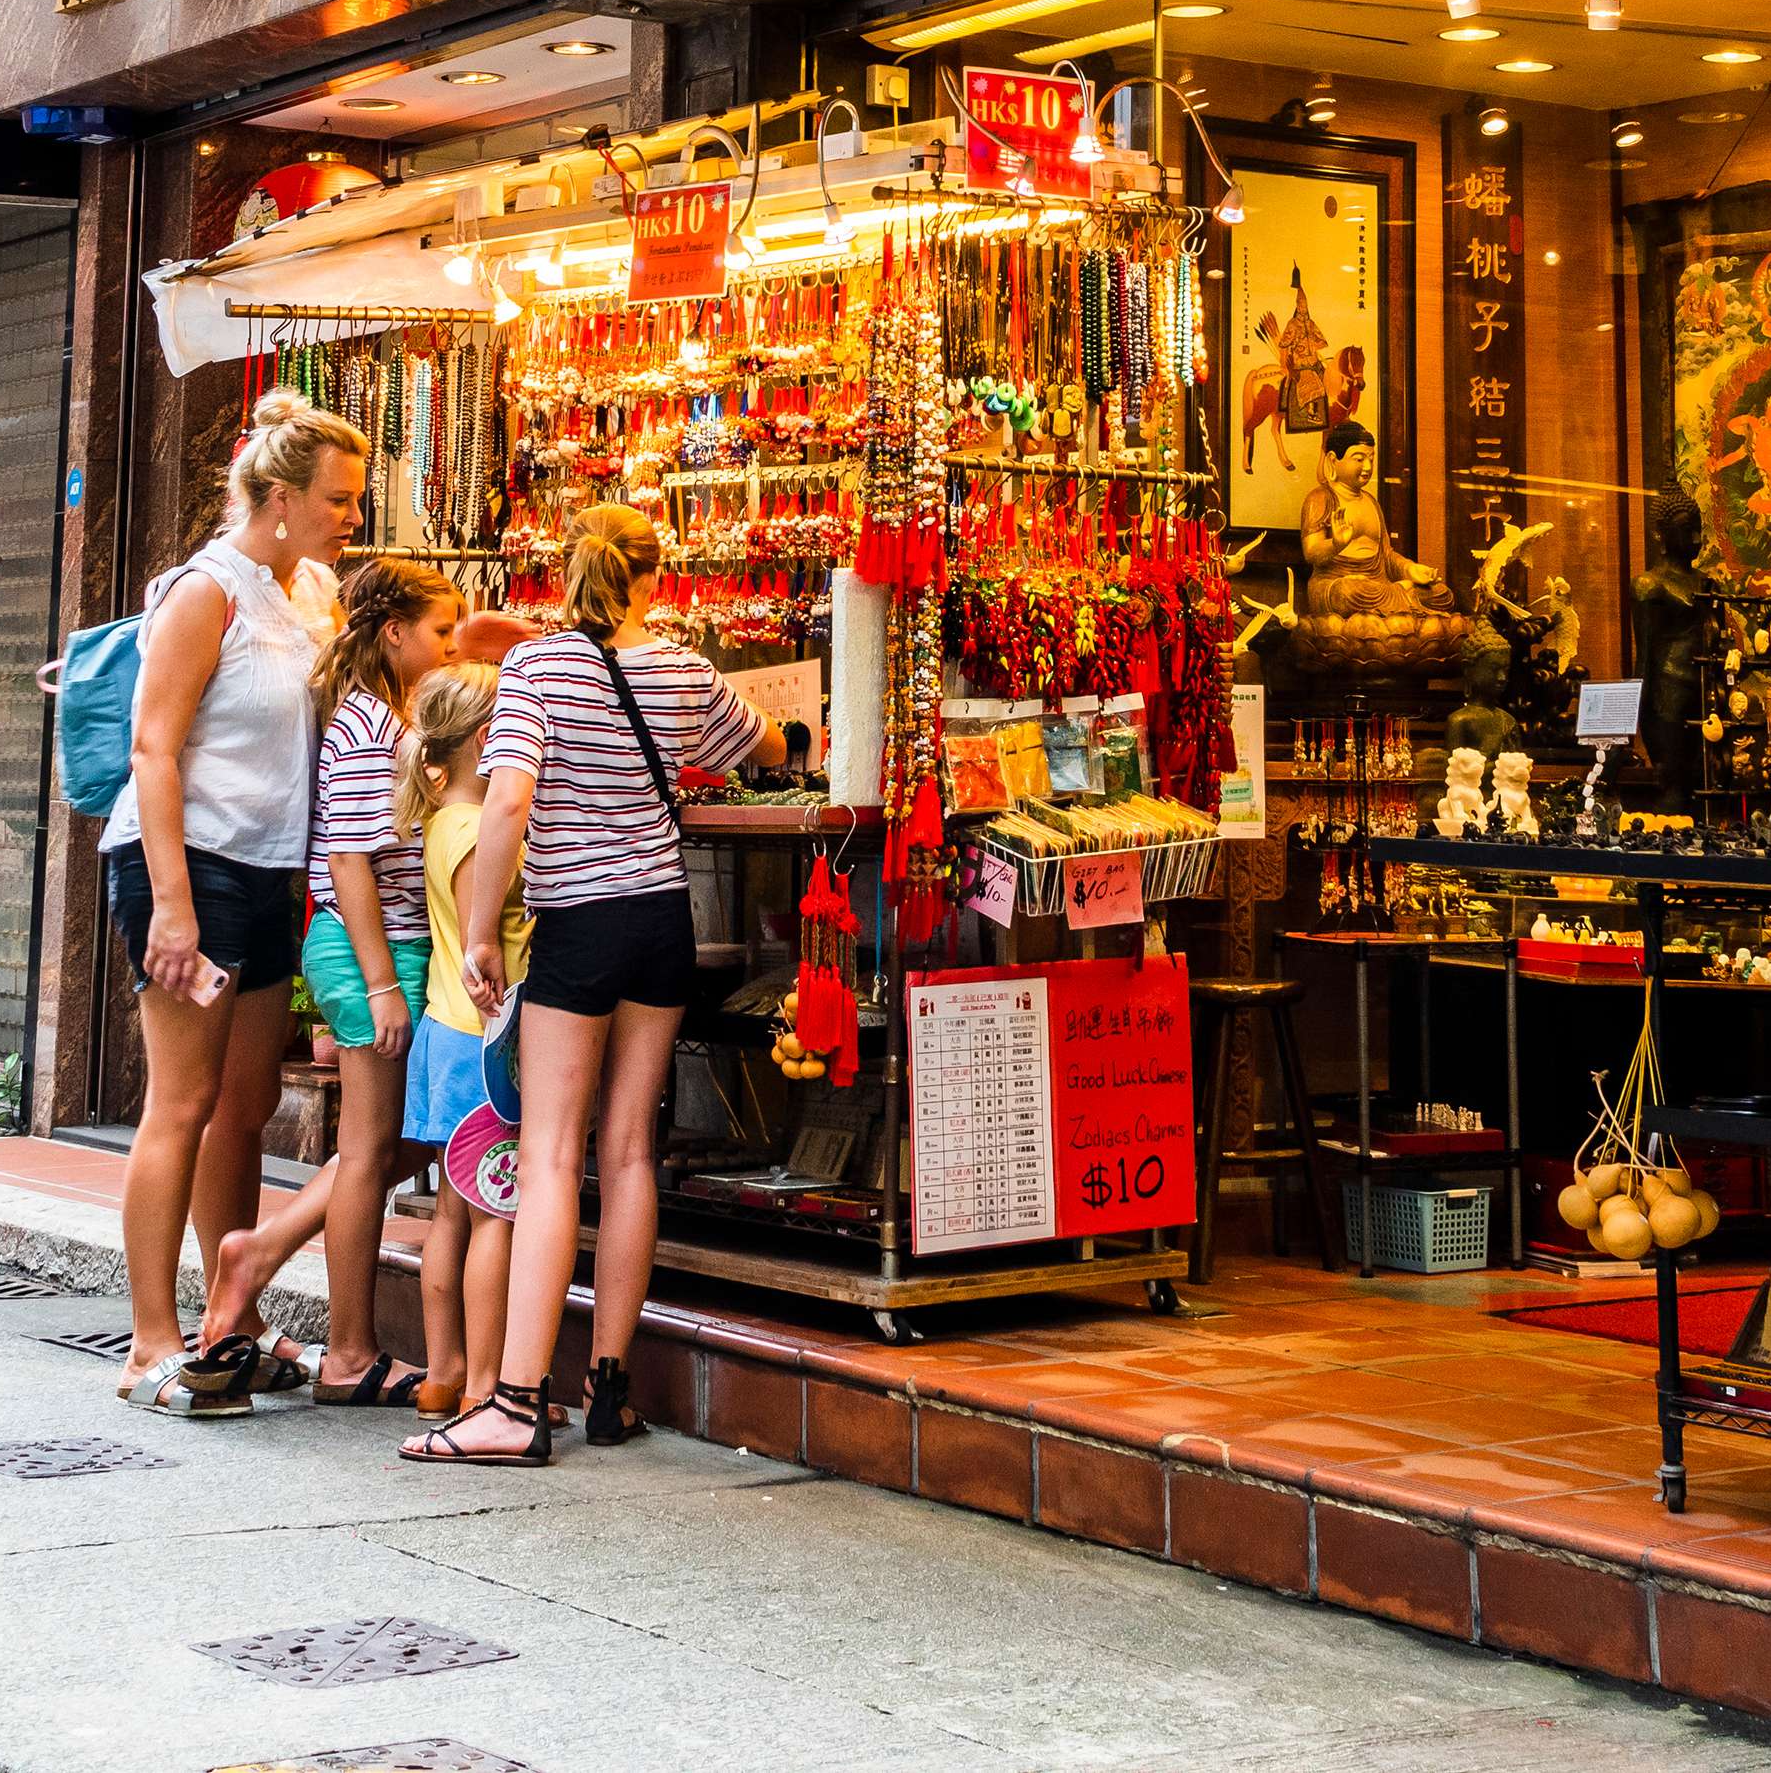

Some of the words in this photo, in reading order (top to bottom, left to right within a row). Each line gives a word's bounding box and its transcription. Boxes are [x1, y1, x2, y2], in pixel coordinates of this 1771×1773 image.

[1067, 1063, 1106, 1089] Good
[1112, 1060, 1149, 1088] Luck
[1069, 1114, 1131, 1150] Zodiacs
[1134, 1113, 1186, 1144] Charms
[1081, 1155, 1165, 1211] $10
